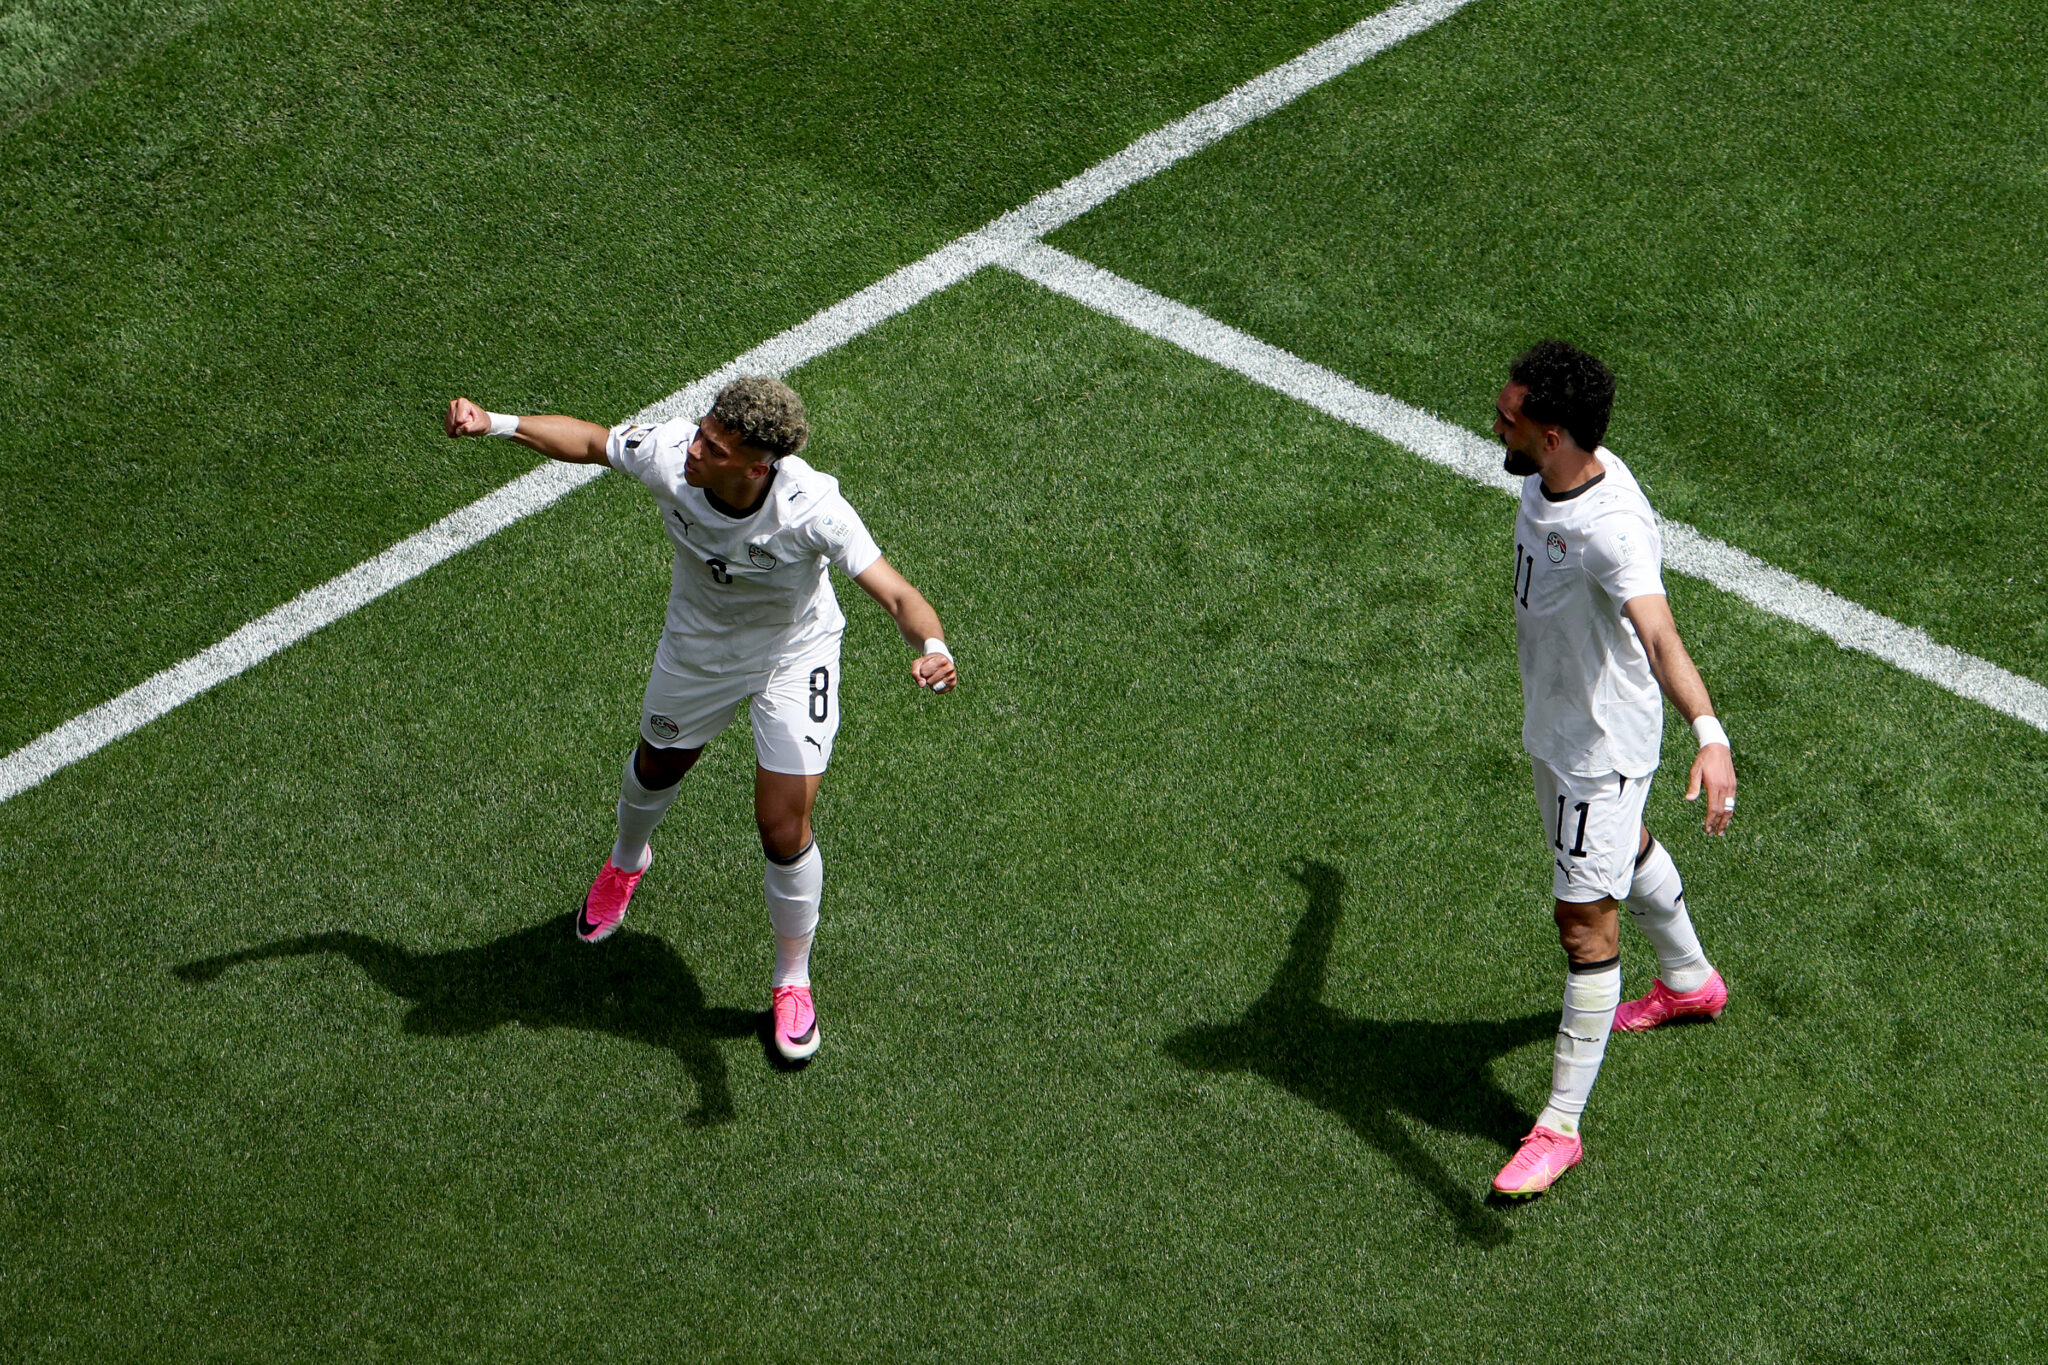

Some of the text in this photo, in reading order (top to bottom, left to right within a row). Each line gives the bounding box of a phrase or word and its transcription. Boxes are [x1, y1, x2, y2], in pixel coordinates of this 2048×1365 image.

[1514, 543, 1534, 610] 11
[809, 666, 829, 723] 8
[1555, 794, 1591, 858] 11
